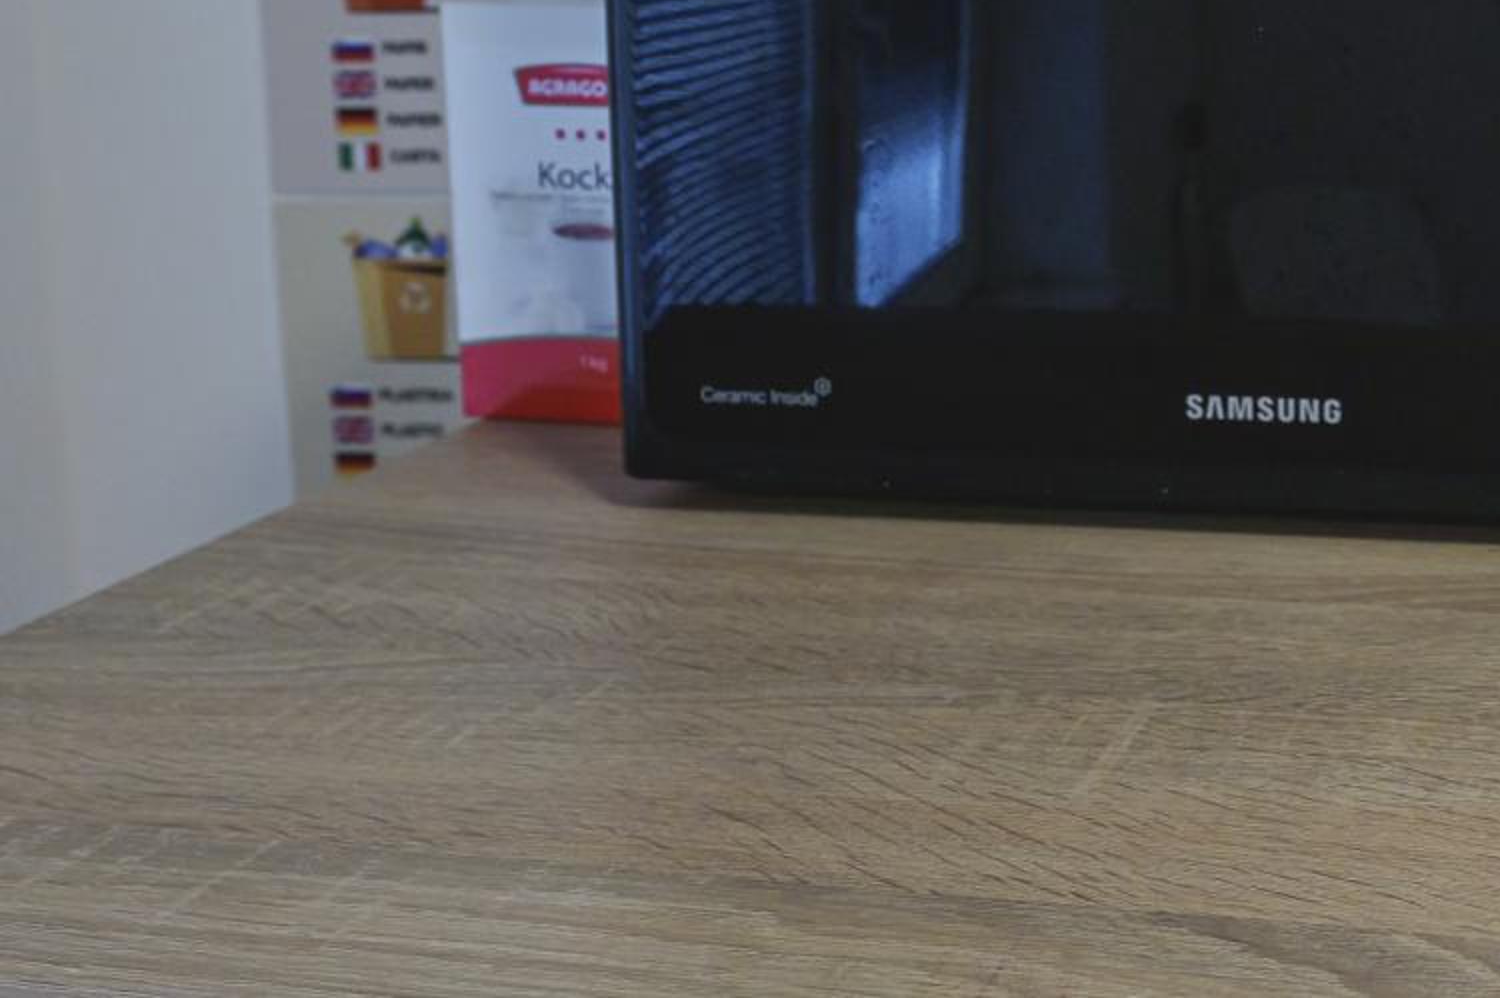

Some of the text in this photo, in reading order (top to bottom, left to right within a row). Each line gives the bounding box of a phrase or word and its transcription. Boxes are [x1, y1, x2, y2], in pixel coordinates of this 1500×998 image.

[701, 385, 819, 407] Ceramic Inside
[1184, 393, 1342, 425] SAMSUNG
